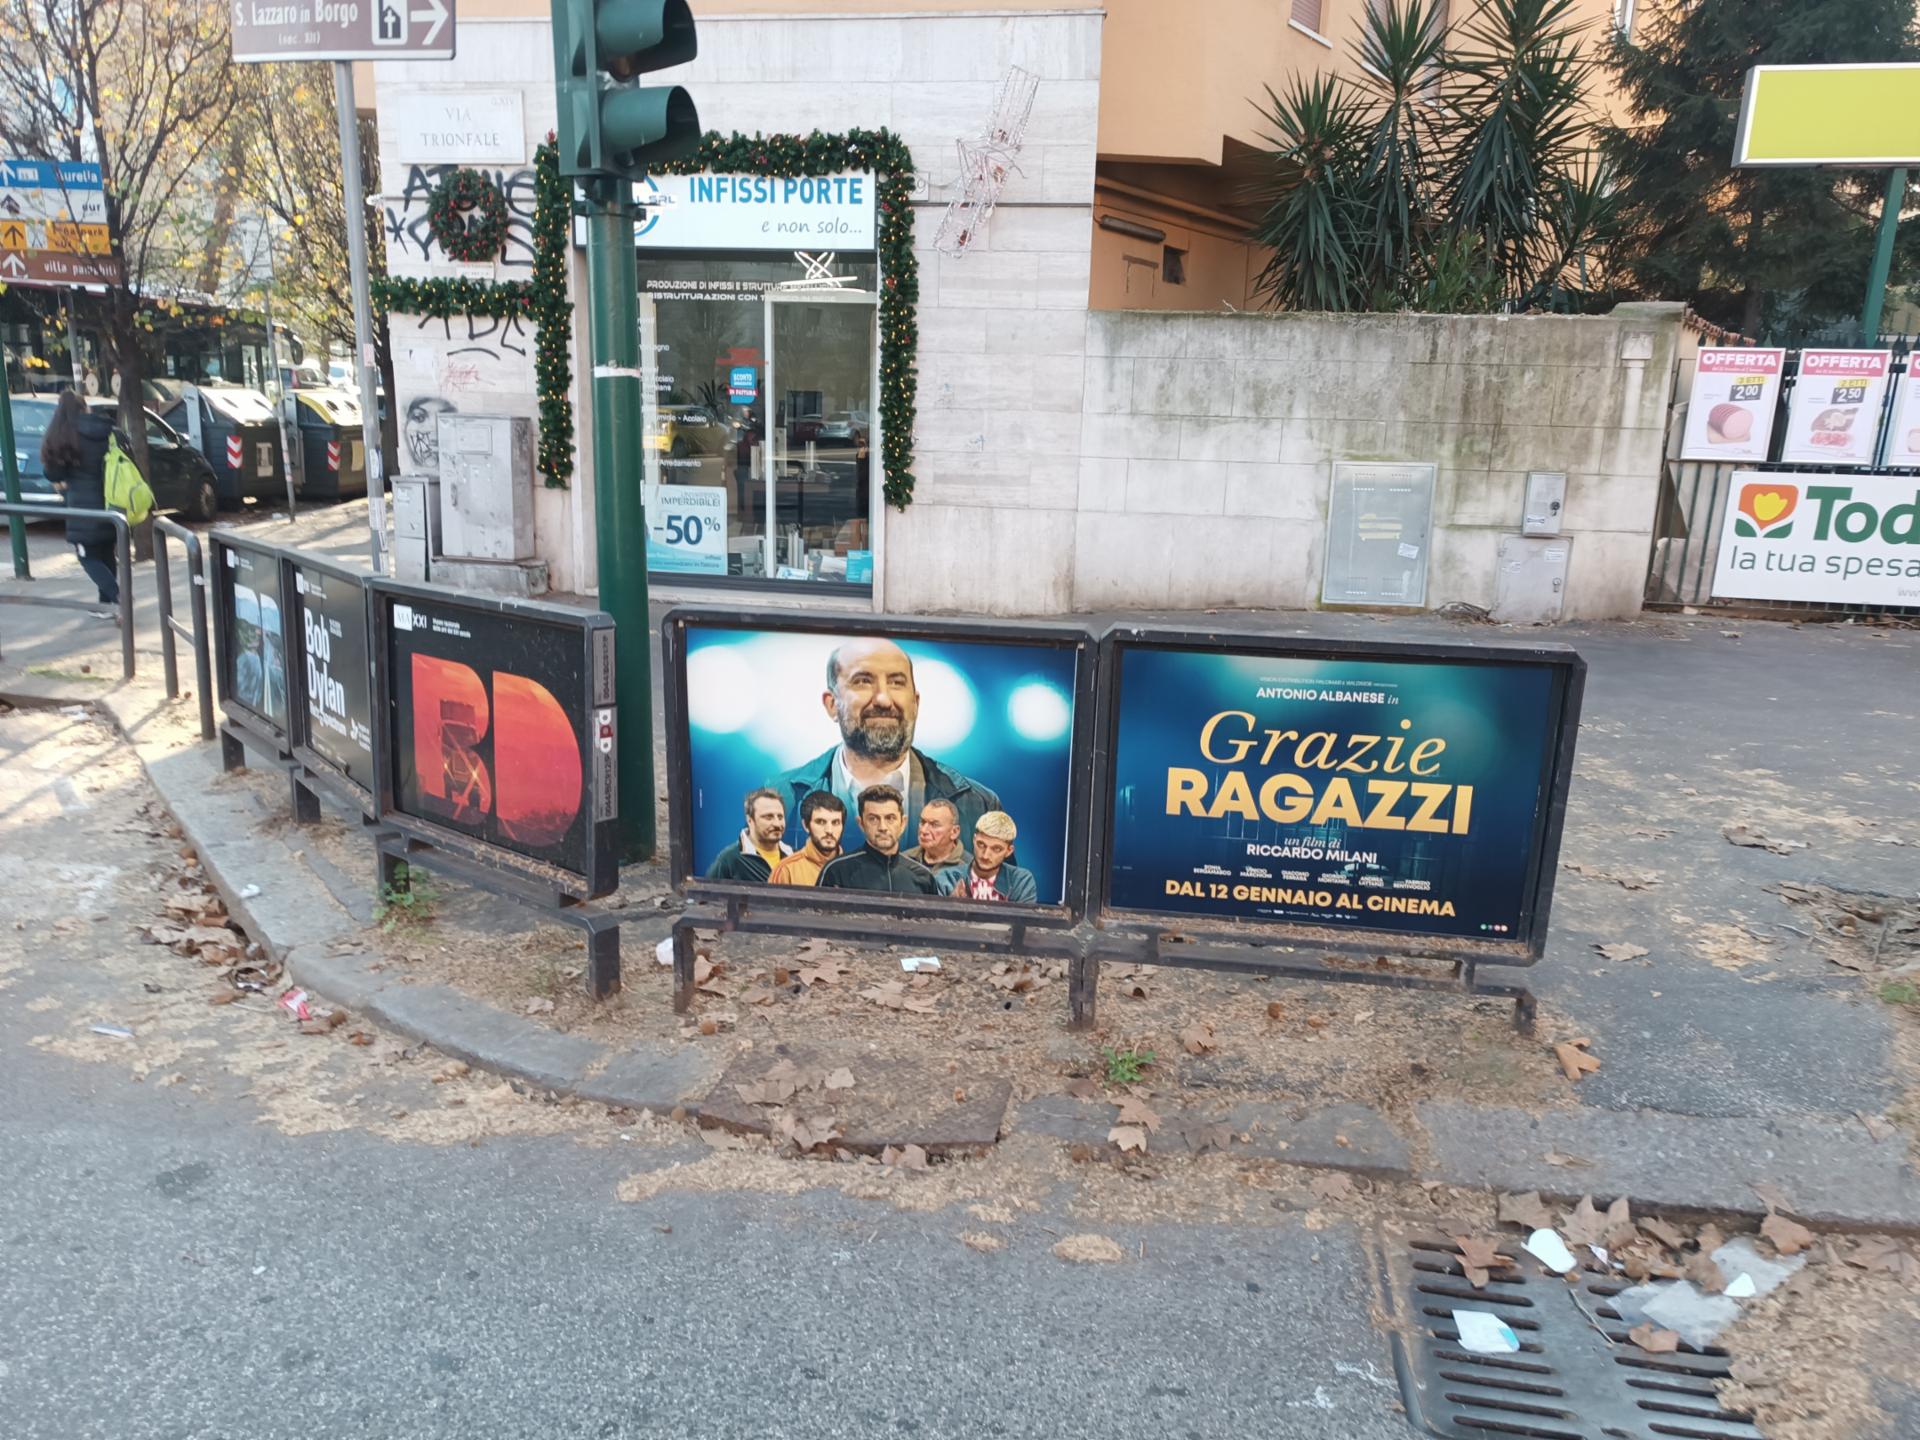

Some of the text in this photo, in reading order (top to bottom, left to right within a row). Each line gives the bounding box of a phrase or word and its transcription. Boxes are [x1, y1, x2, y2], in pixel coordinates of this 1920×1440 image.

[235, 0, 358, 28] S. Lazzaro in Borgo
[445, 107, 471, 121] VIA
[420, 132, 500, 146] TRIONFALE
[689, 176, 863, 204] INFISSI PORTE
[761, 220, 770, 232] e
[778, 221, 811, 233] non
[646, 279, 698, 290] PRODUZIONE
[699, 281, 707, 290] DI
[708, 281, 735, 291] INFISSI
[648, 292, 736, 301] RISTRUTTURAZIONI
[737, 294, 758, 302] CON
[1702, 352, 1777, 367] OFFERTA
[1806, 355, 1882, 369] OFFERTA
[654, 515, 721, 545] -50%
[1730, 545, 1920, 580] la tua spesa
[304, 606, 331, 664] Bob
[306, 653, 346, 718] Dylan
[1256, 687, 1399, 705] ANTONIO ALBANESE in
[1199, 709, 1447, 776] Grazie
[1166, 766, 1474, 835] RAGAZZI
[1284, 835, 1342, 850] un film di
[1247, 843, 1378, 865] RICCARDO MILANI
[1165, 879, 1206, 898] DAL
[1209, 883, 1228, 900] 12
[1233, 884, 1333, 908] GENNAIO
[1335, 893, 1363, 911] AL
[1366, 894, 1456, 917] CINEMA
